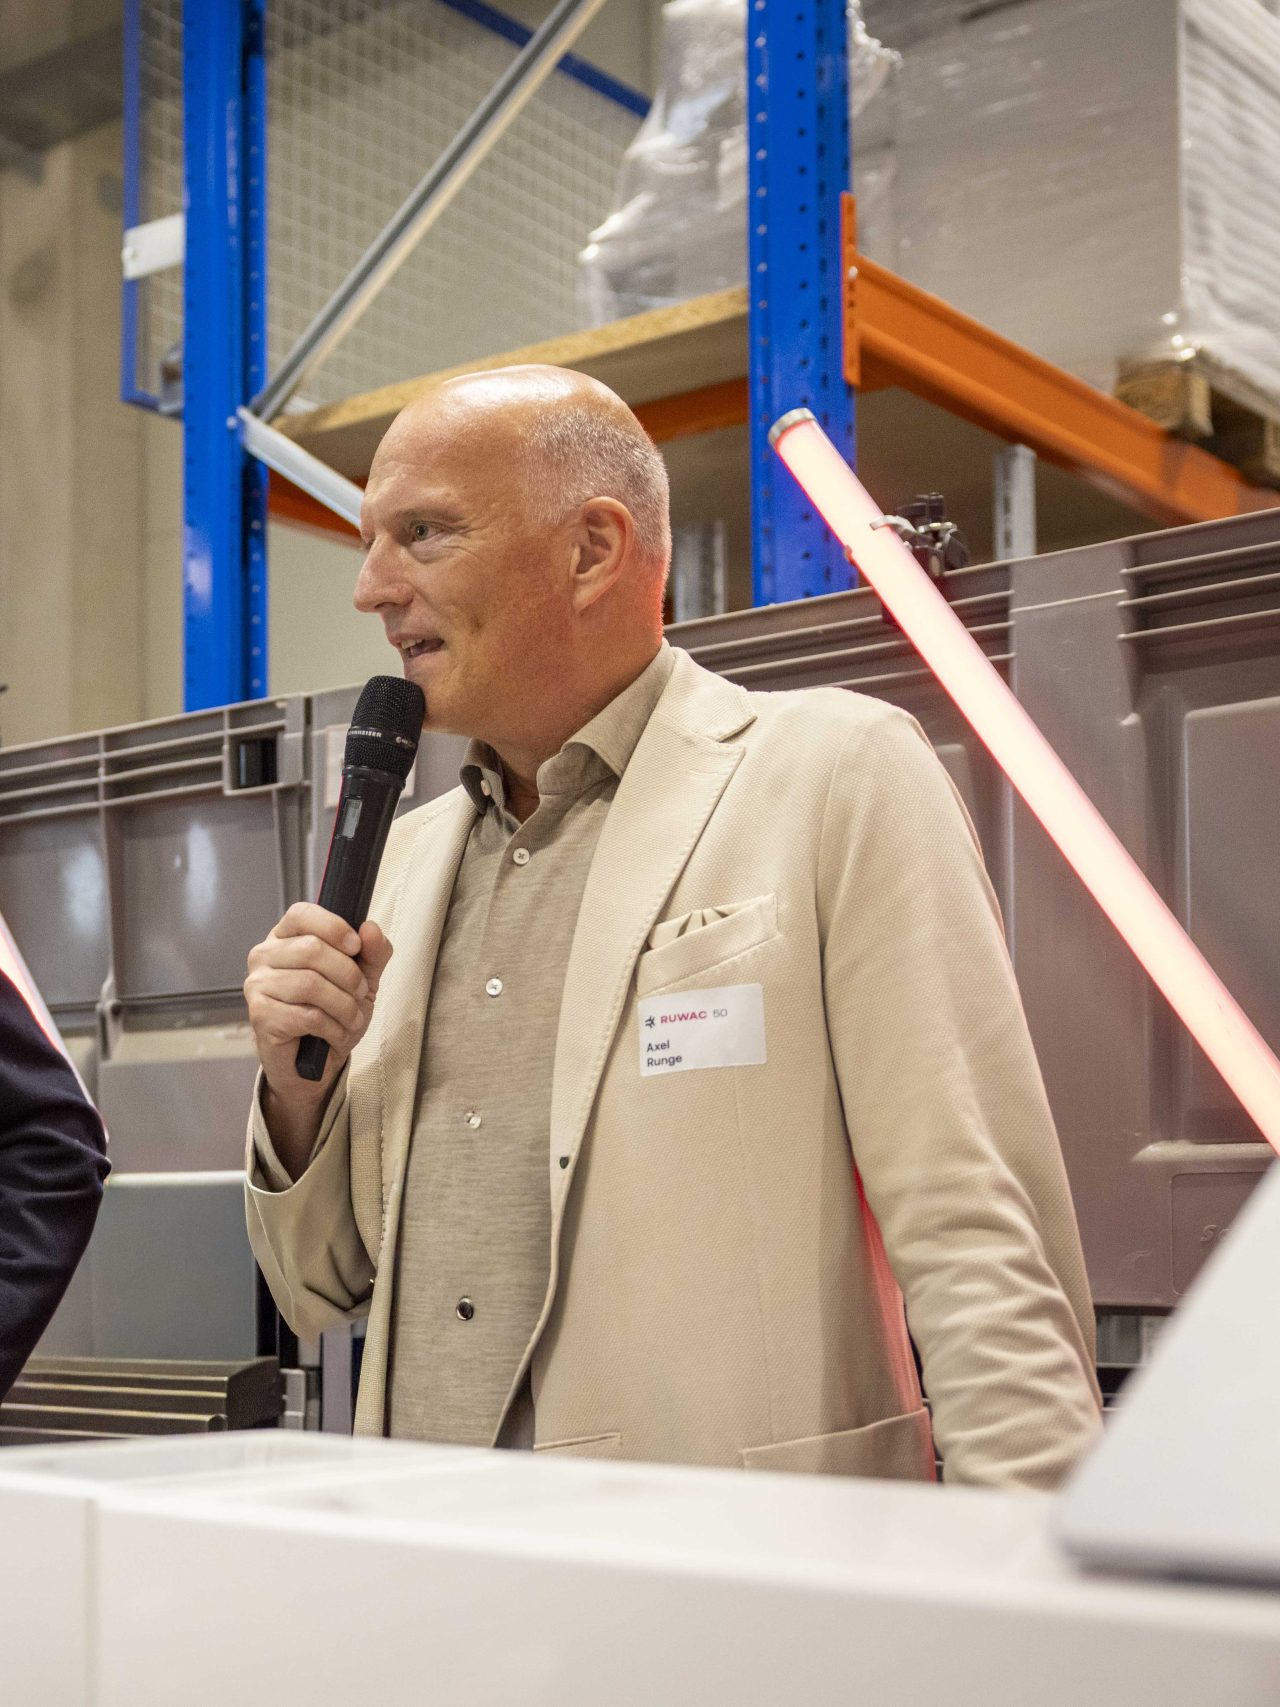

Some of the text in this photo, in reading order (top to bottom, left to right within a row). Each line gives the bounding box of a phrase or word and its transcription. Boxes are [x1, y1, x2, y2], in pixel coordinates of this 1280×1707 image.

[348, 730, 382, 738] NNHEISER
[660, 1008, 728, 1024] RUWAC 50
[647, 1040, 670, 1053] Axel
[647, 1055, 682, 1067] Runge
